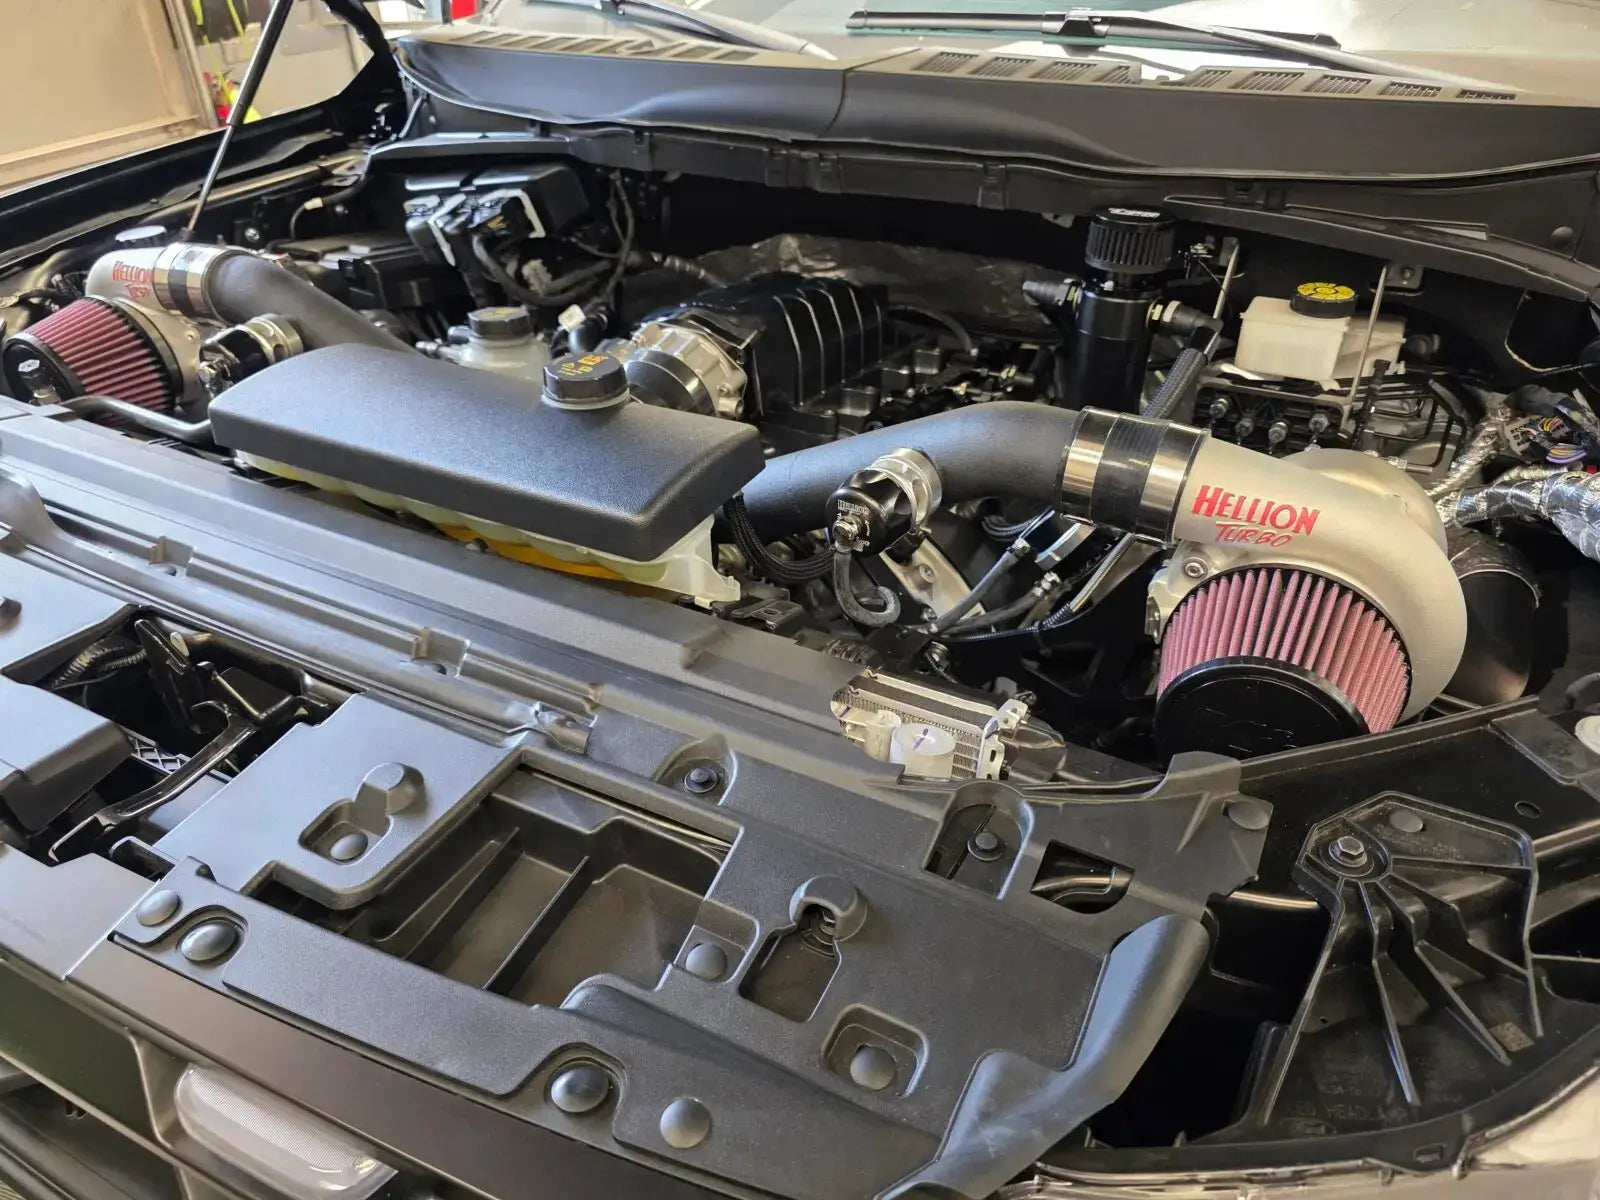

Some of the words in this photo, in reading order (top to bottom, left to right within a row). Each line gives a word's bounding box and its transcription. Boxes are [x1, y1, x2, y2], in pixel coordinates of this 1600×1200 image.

[112, 260, 152, 282] HELLION
[1192, 485, 1320, 536] HELLION
[1215, 521, 1292, 547] TURBO
